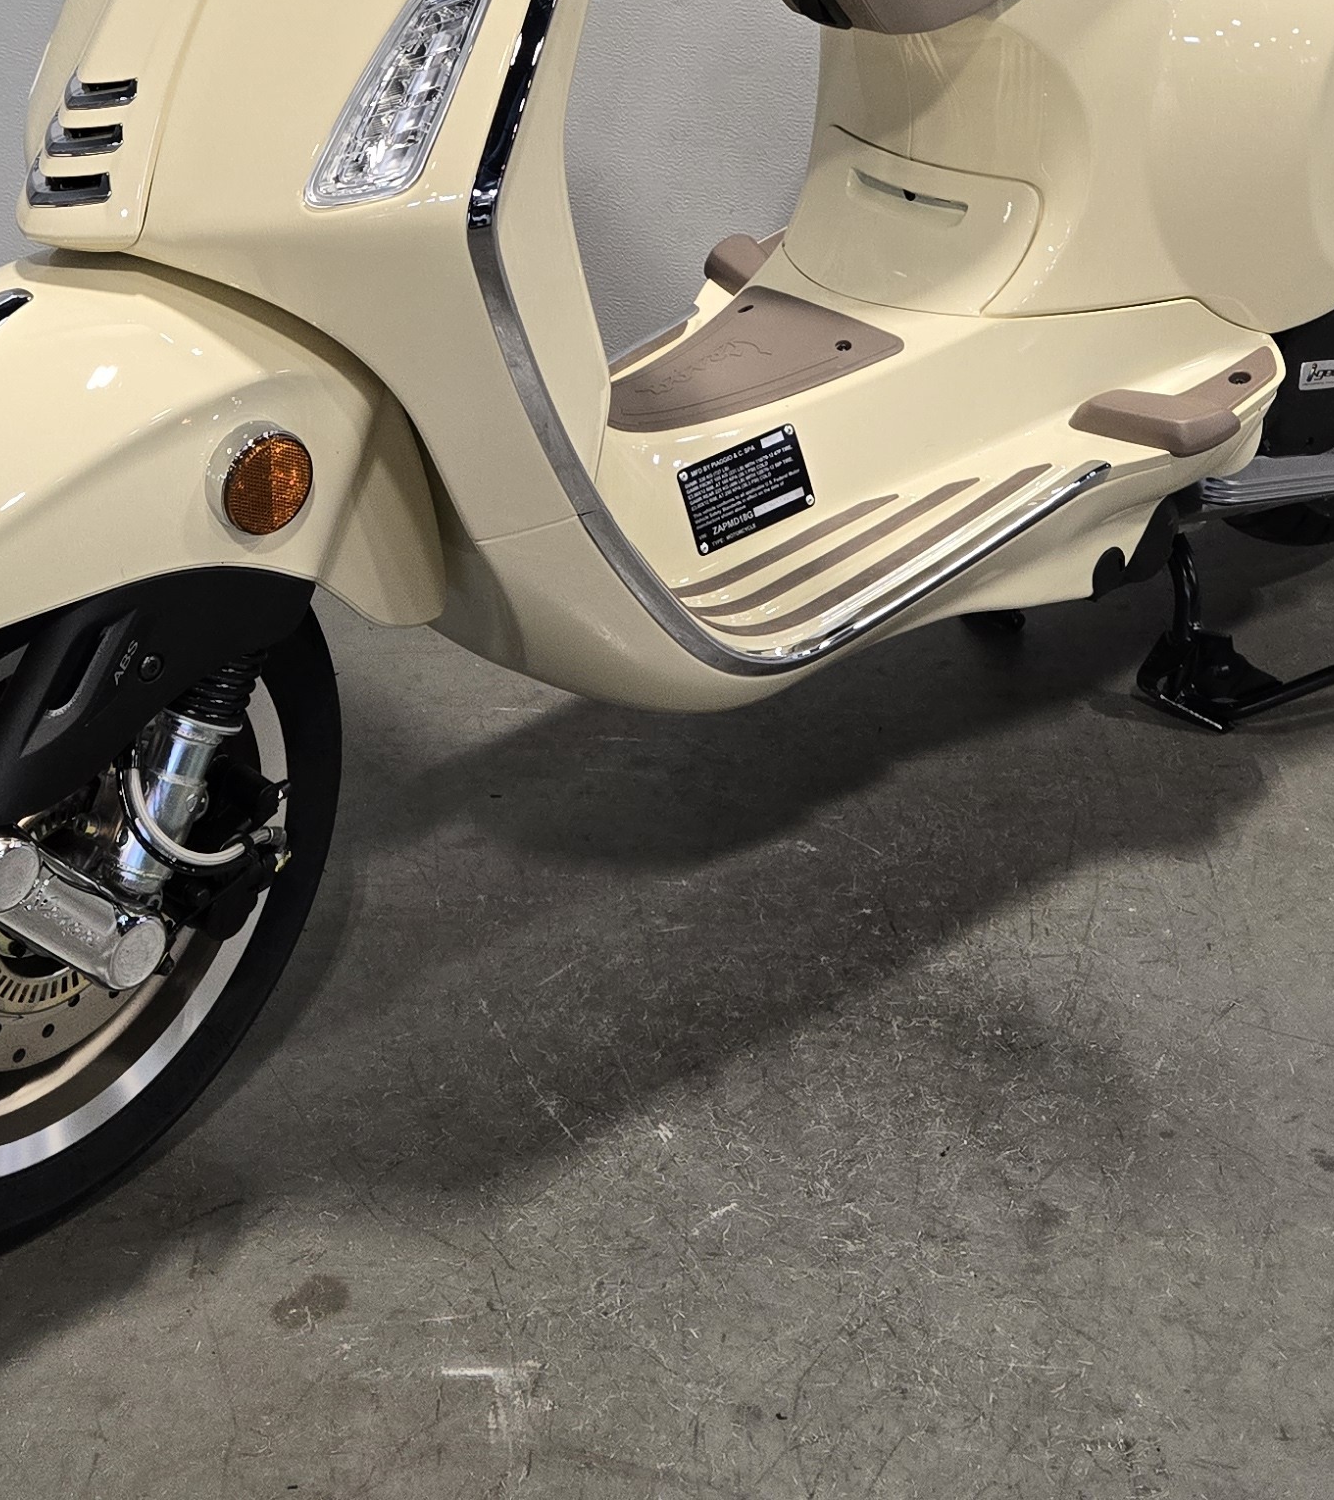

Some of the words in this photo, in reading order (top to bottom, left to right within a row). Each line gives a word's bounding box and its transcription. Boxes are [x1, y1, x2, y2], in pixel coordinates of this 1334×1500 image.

[702, 463, 710, 472] BY
[710, 453, 733, 468] PIAGGIO
[732, 451, 737, 459] &
[113, 640, 138, 686] ABS
